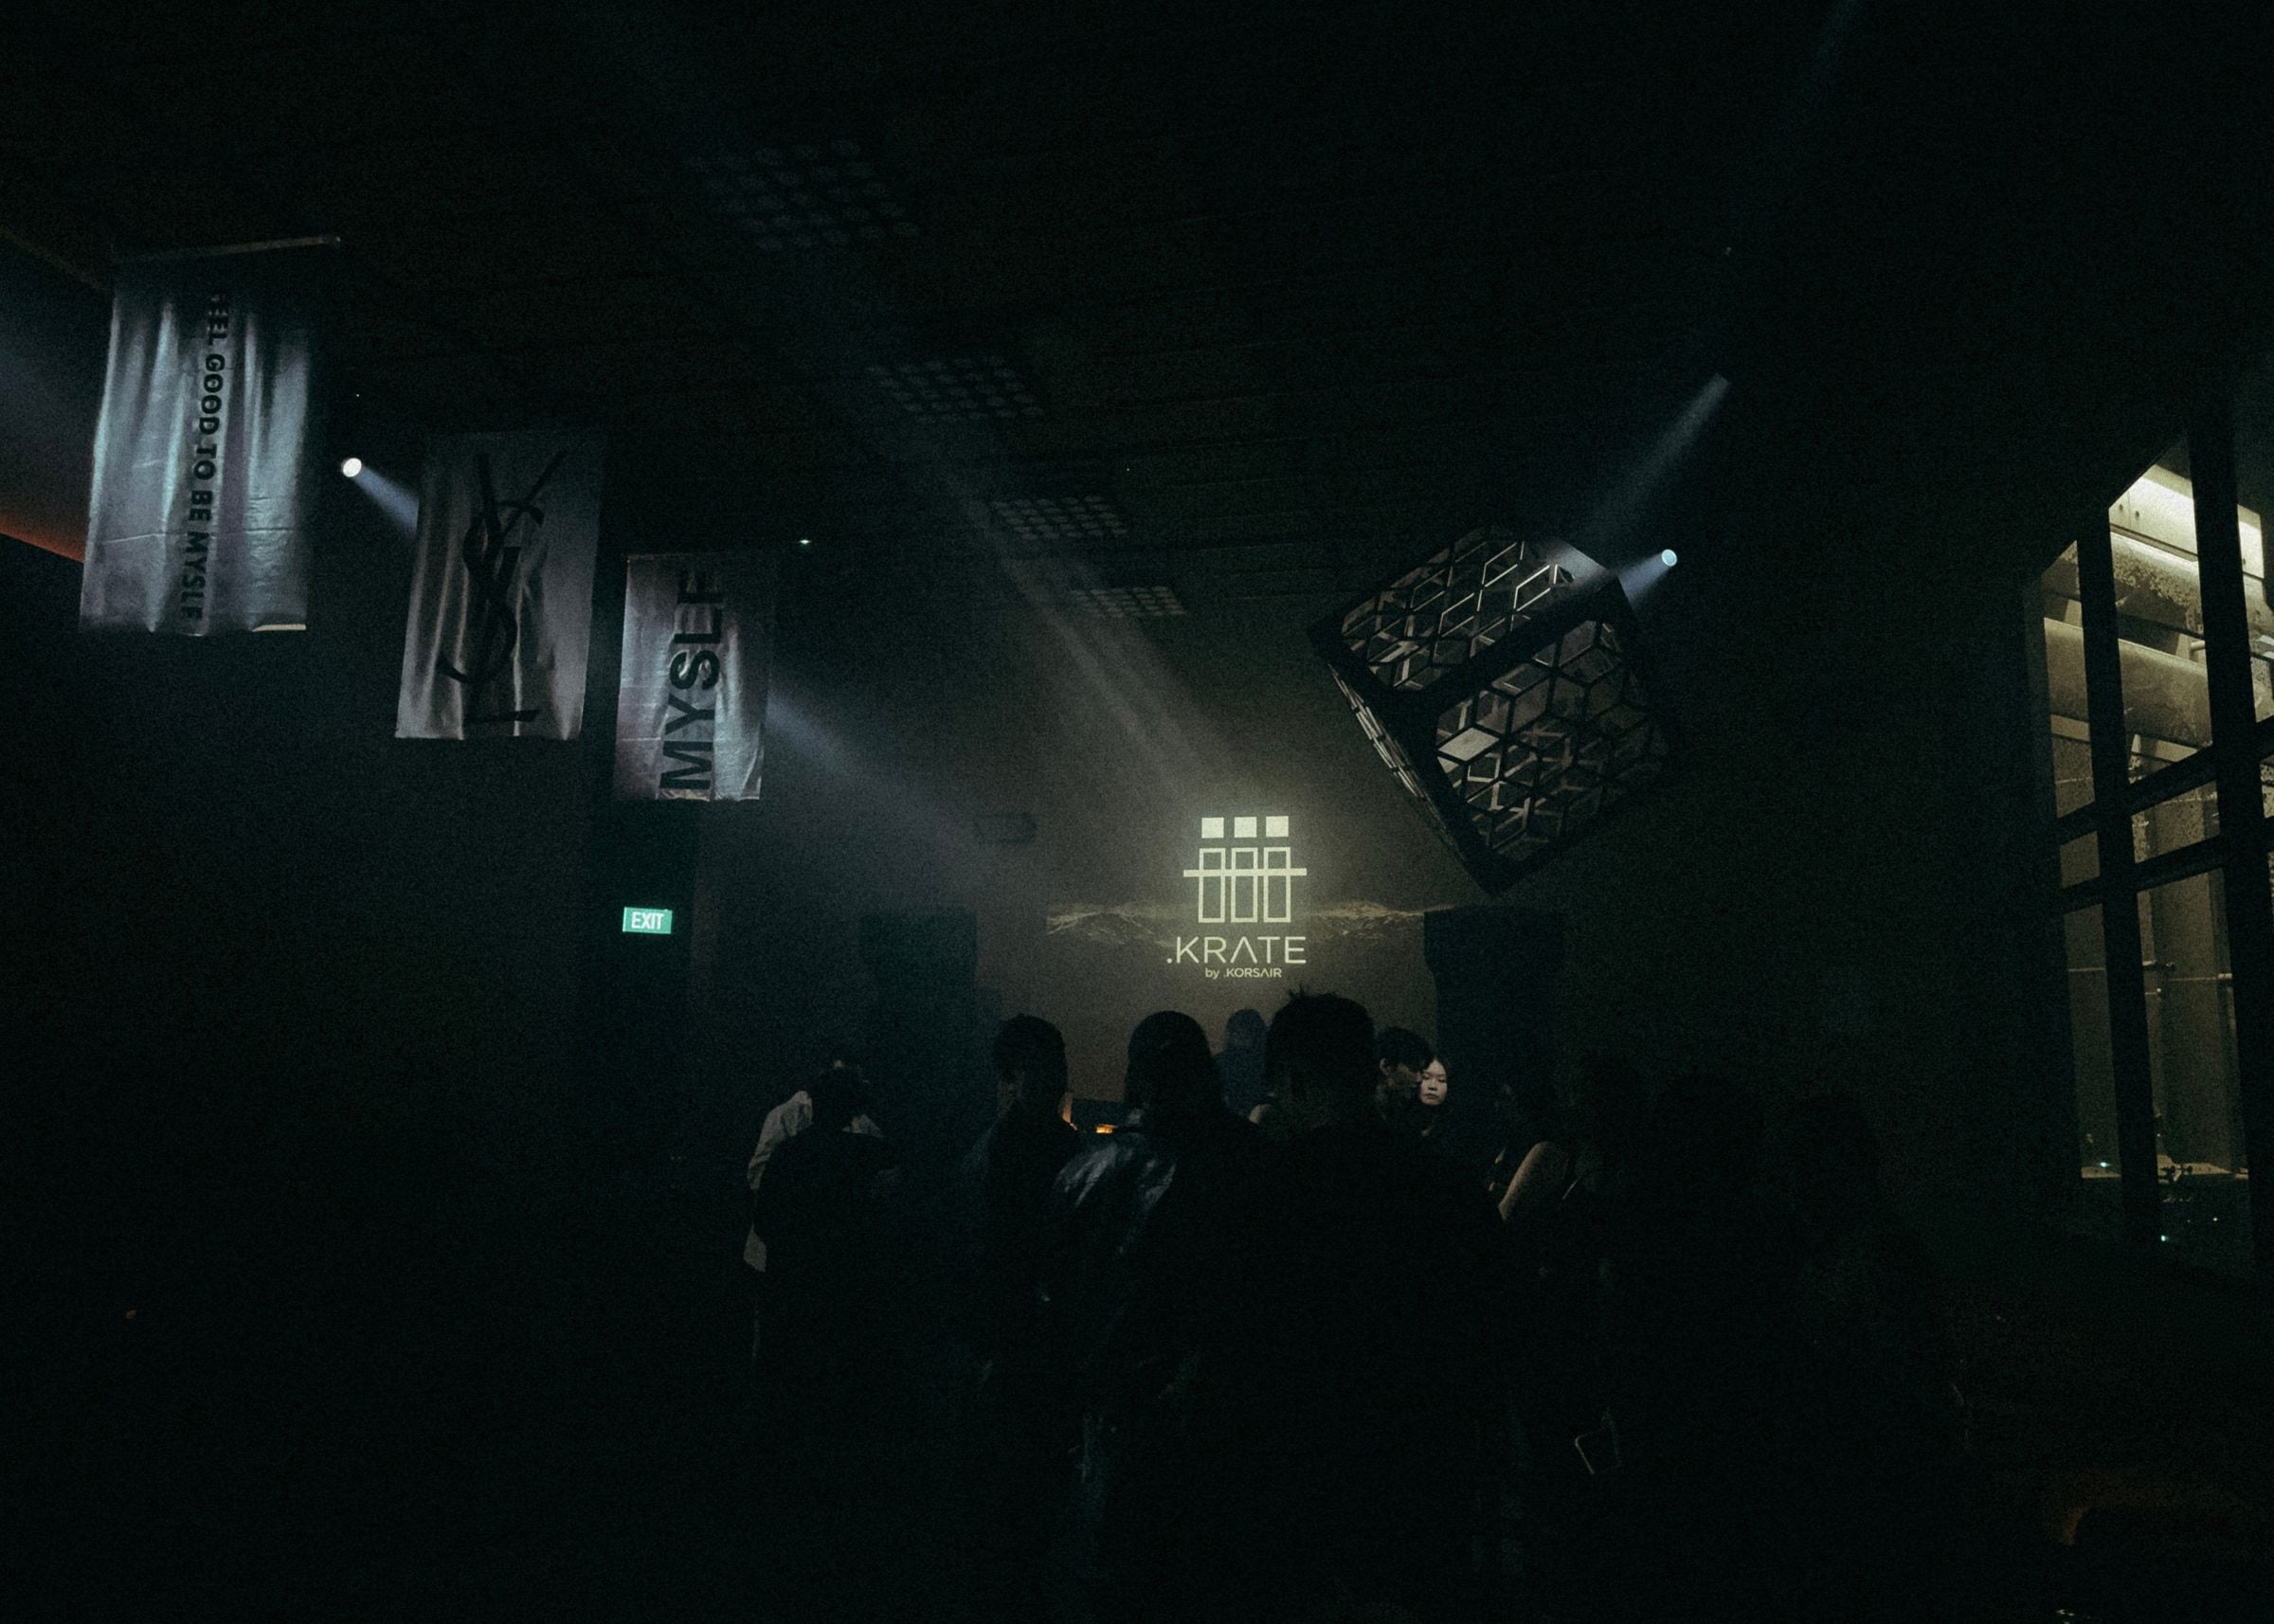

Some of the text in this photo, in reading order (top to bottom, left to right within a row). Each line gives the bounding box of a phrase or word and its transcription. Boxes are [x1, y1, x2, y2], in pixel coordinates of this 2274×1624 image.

[199, 353, 226, 435] GOOD
[193, 442, 217, 480] TO
[190, 490, 213, 521] BE
[181, 531, 209, 619] MYSLF
[659, 570, 723, 790] MYSLF
[631, 911, 665, 929] EXIT
[1204, 967, 1220, 980] by
